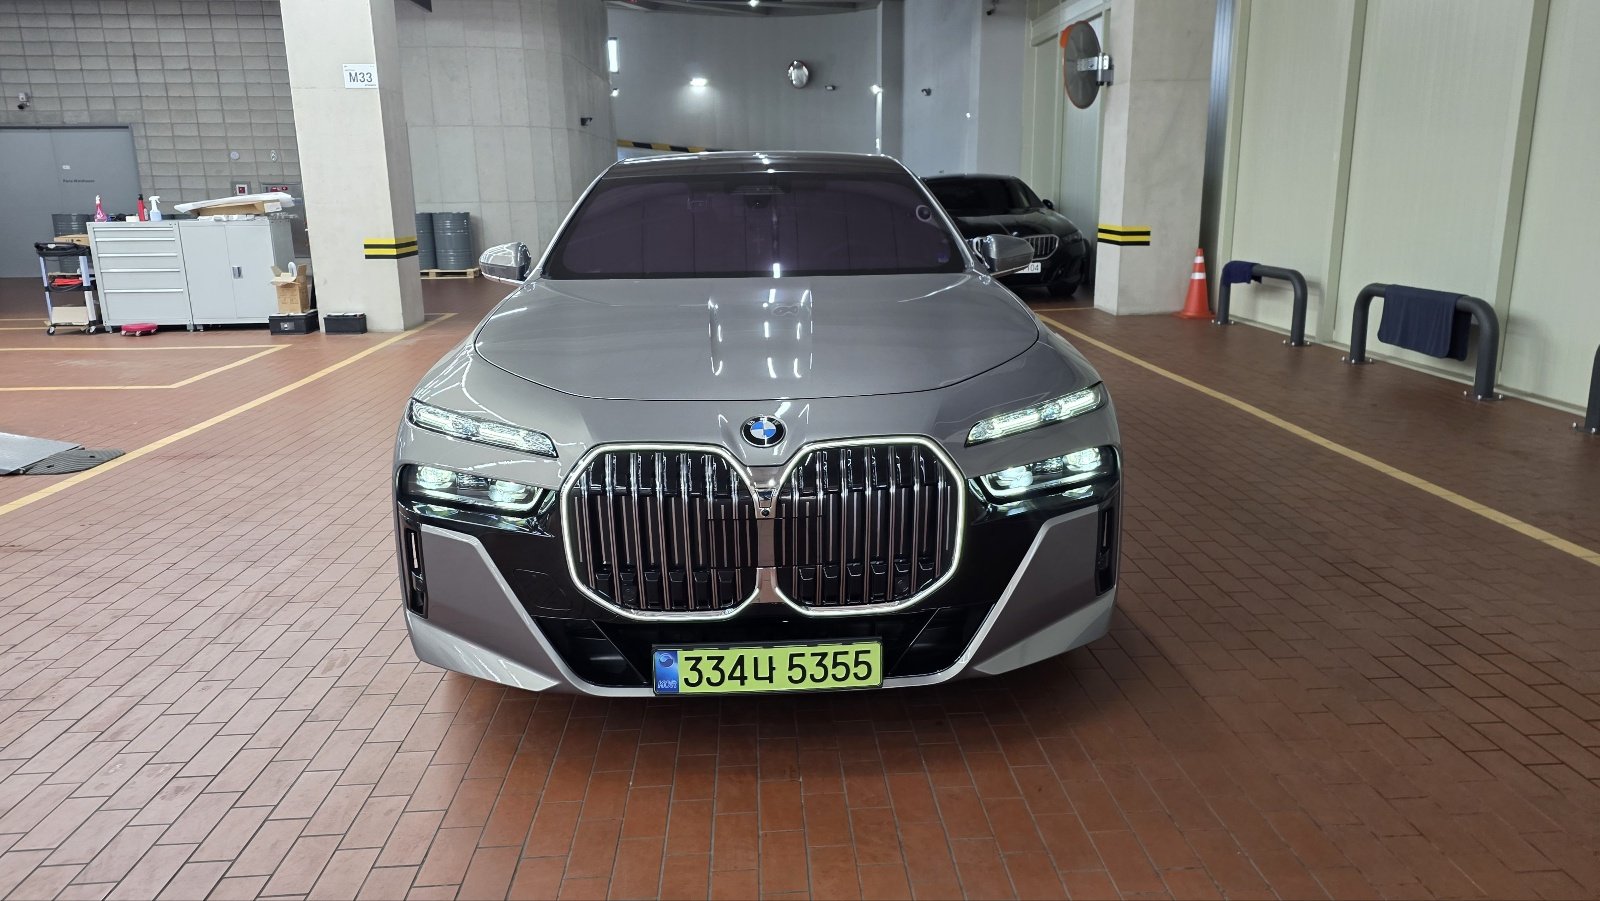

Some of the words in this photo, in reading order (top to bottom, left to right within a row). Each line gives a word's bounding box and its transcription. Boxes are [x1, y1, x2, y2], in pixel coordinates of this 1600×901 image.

[349, 72, 373, 83] M33
[683, 654, 776, 688] 334나
[787, 650, 872, 684] 5355
